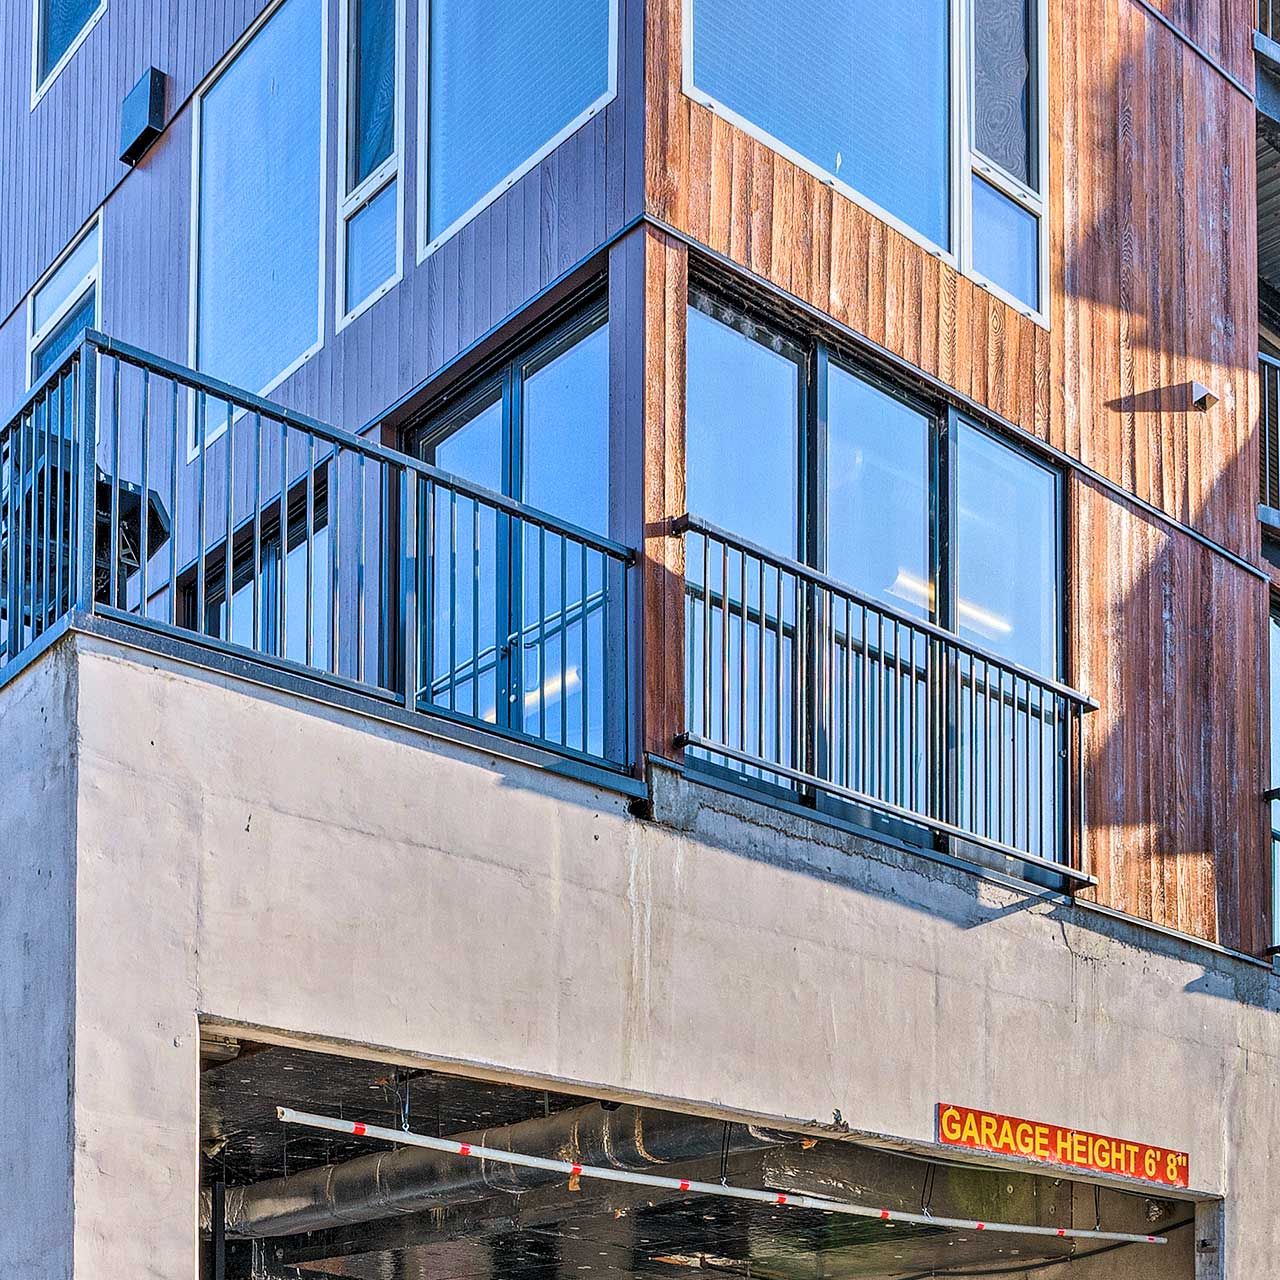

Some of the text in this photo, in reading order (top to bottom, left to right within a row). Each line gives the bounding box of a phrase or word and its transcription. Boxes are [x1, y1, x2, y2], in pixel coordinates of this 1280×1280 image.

[941, 1107, 1187, 1182] GARAGE HEIGHT 6' 8"
